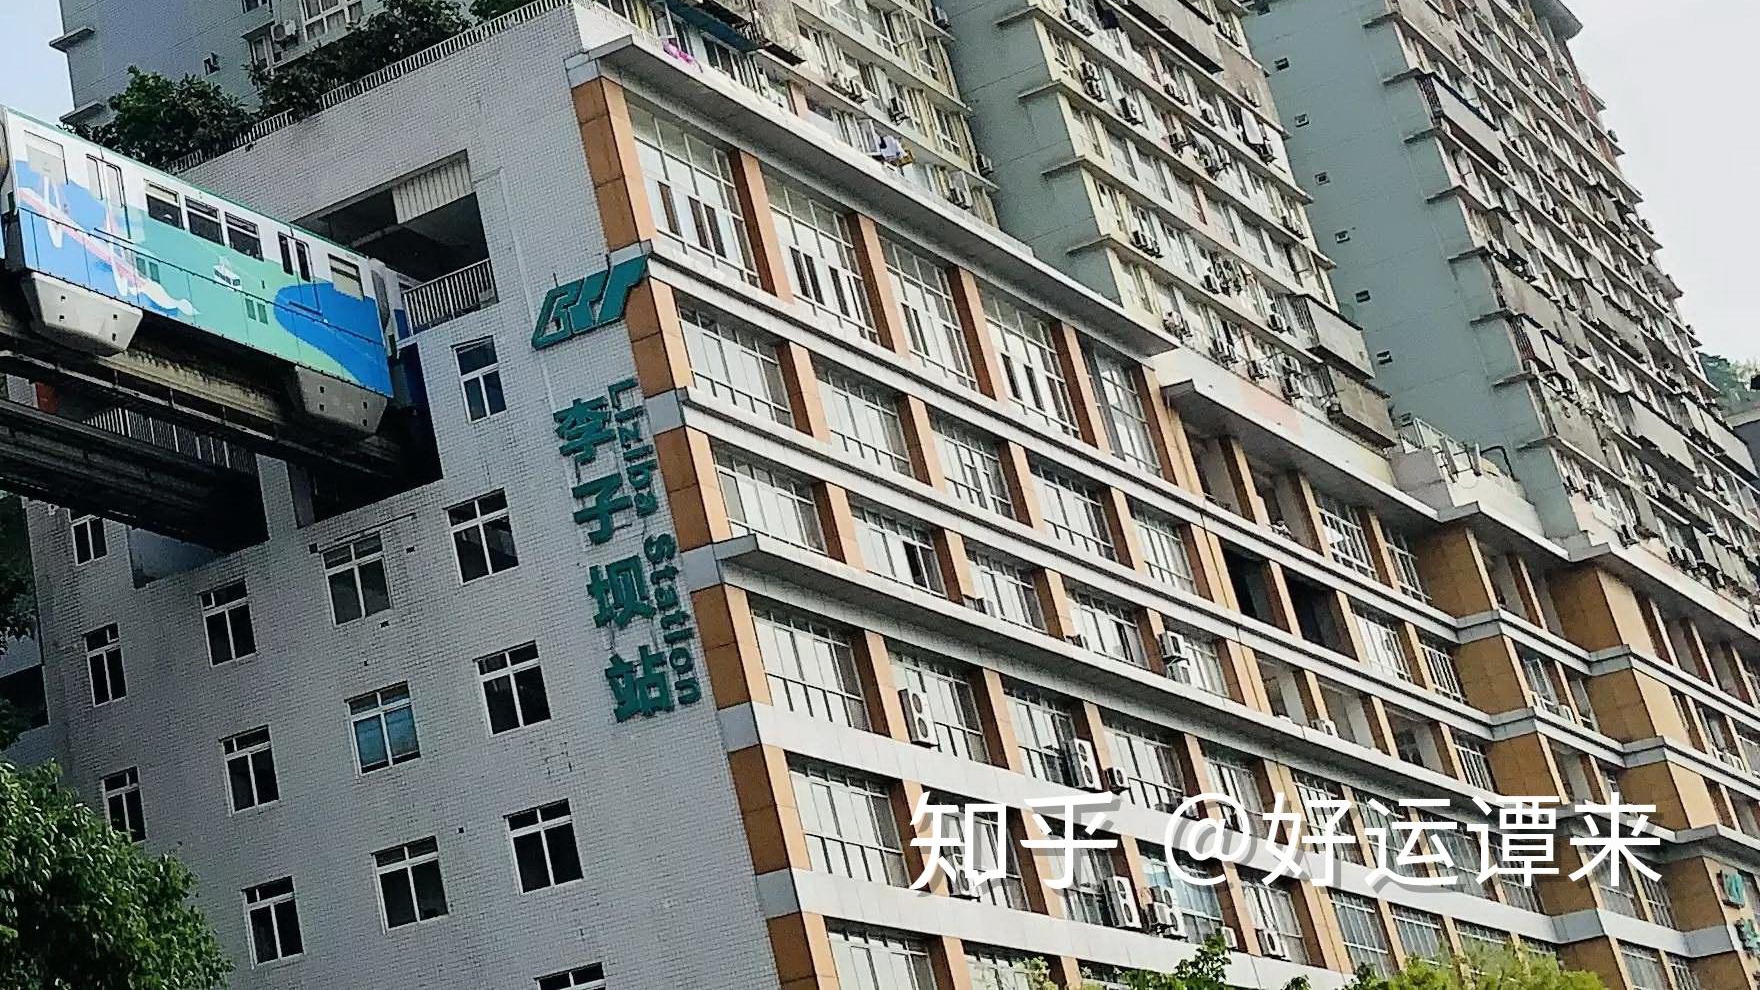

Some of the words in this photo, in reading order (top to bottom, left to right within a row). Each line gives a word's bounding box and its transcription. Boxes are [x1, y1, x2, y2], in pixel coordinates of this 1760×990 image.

[553, 395, 675, 723] 李子坝站
[608, 378, 658, 517] Liziba
[643, 533, 701, 705] Station
